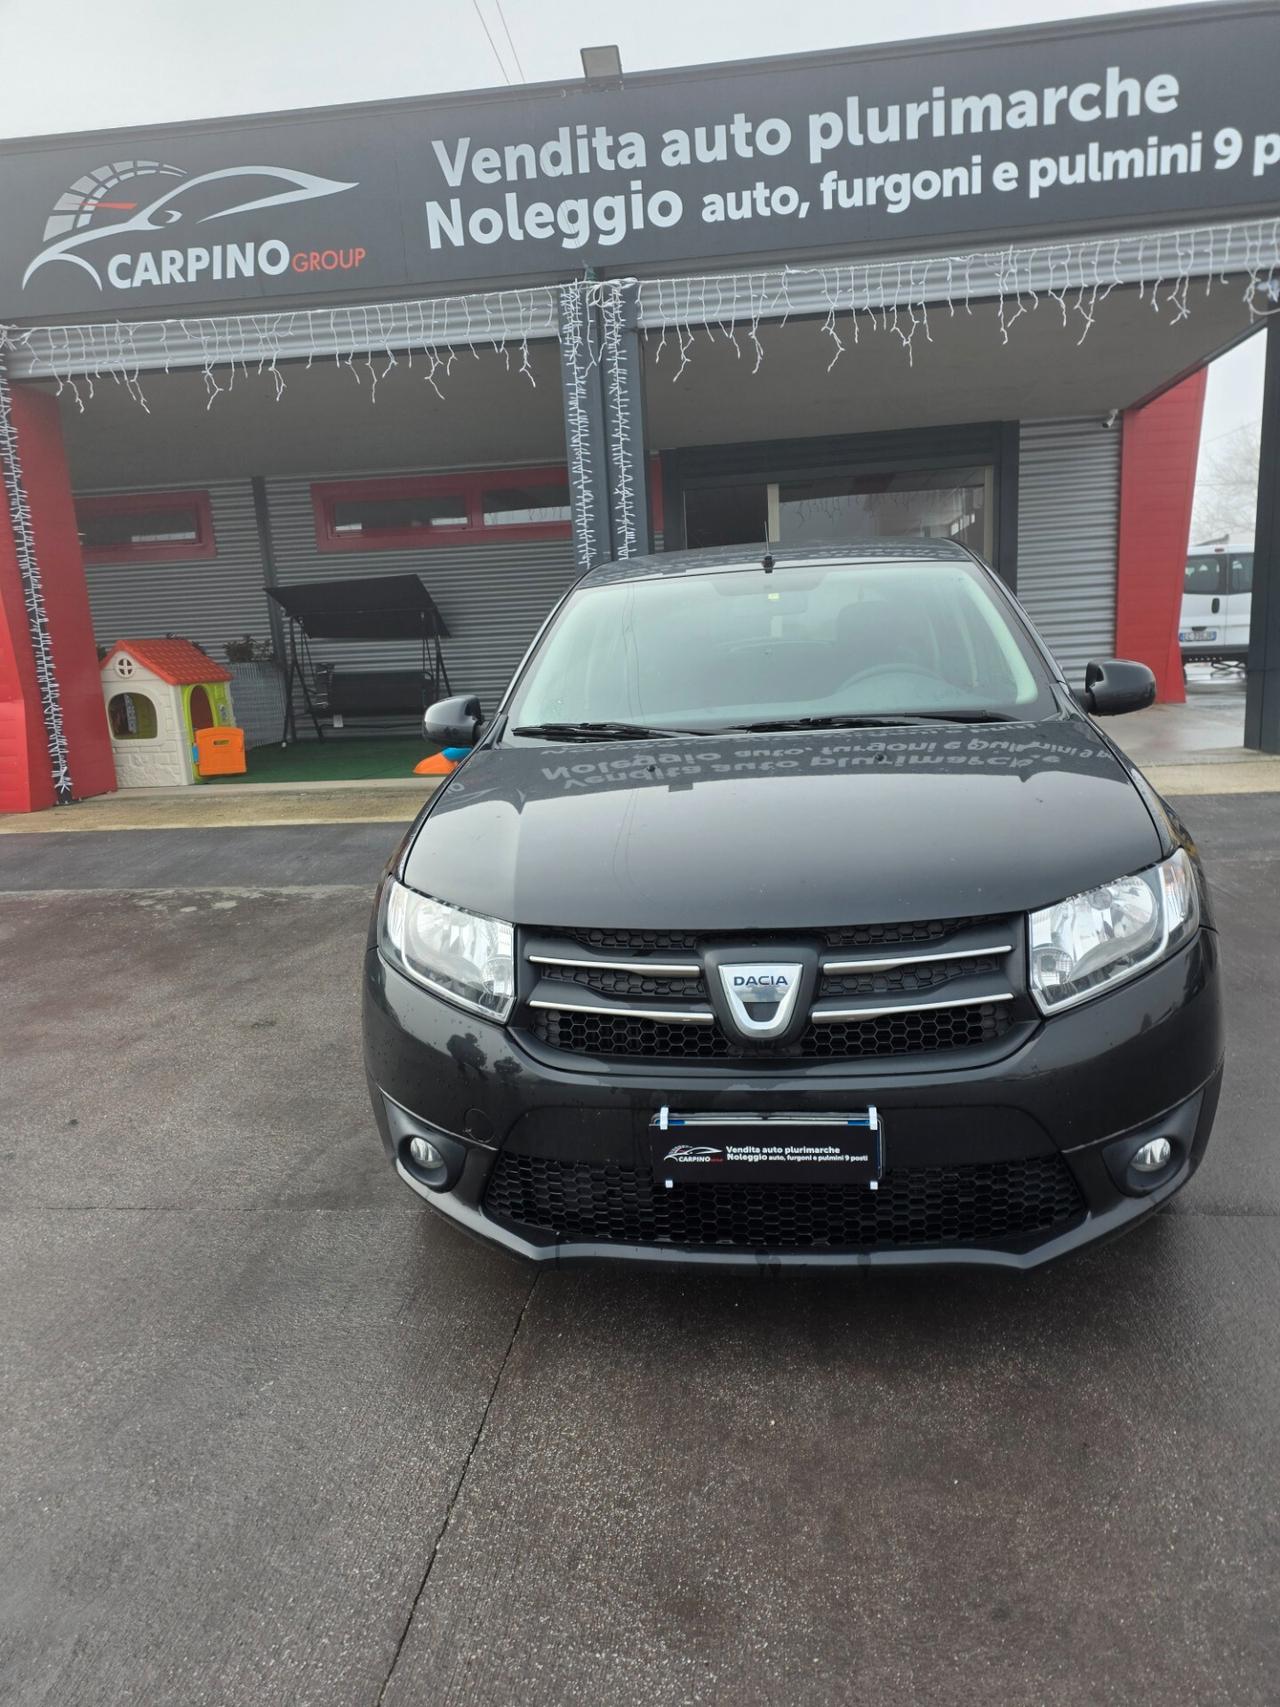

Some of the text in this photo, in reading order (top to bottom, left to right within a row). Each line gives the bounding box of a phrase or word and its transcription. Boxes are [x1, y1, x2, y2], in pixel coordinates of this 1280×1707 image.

[432, 67, 1179, 187] Vendita auto plurimarche
[426, 180, 684, 249] Noleggio
[702, 182, 811, 223] auto,
[820, 154, 981, 213] furgoni
[992, 161, 1019, 191] e
[1029, 131, 1202, 198] pulmini
[1214, 128, 1242, 169] 9
[107, 239, 367, 290] CARPINO GROUP
[733, 976, 788, 986] DACIA
[726, 1145, 841, 1155] Vendita auto plurimarche
[727, 1153, 768, 1163] Noleggio
[786, 1154, 813, 1163] furgoni
[818, 1154, 845, 1163] pulmini
[850, 1154, 869, 1163] posti
